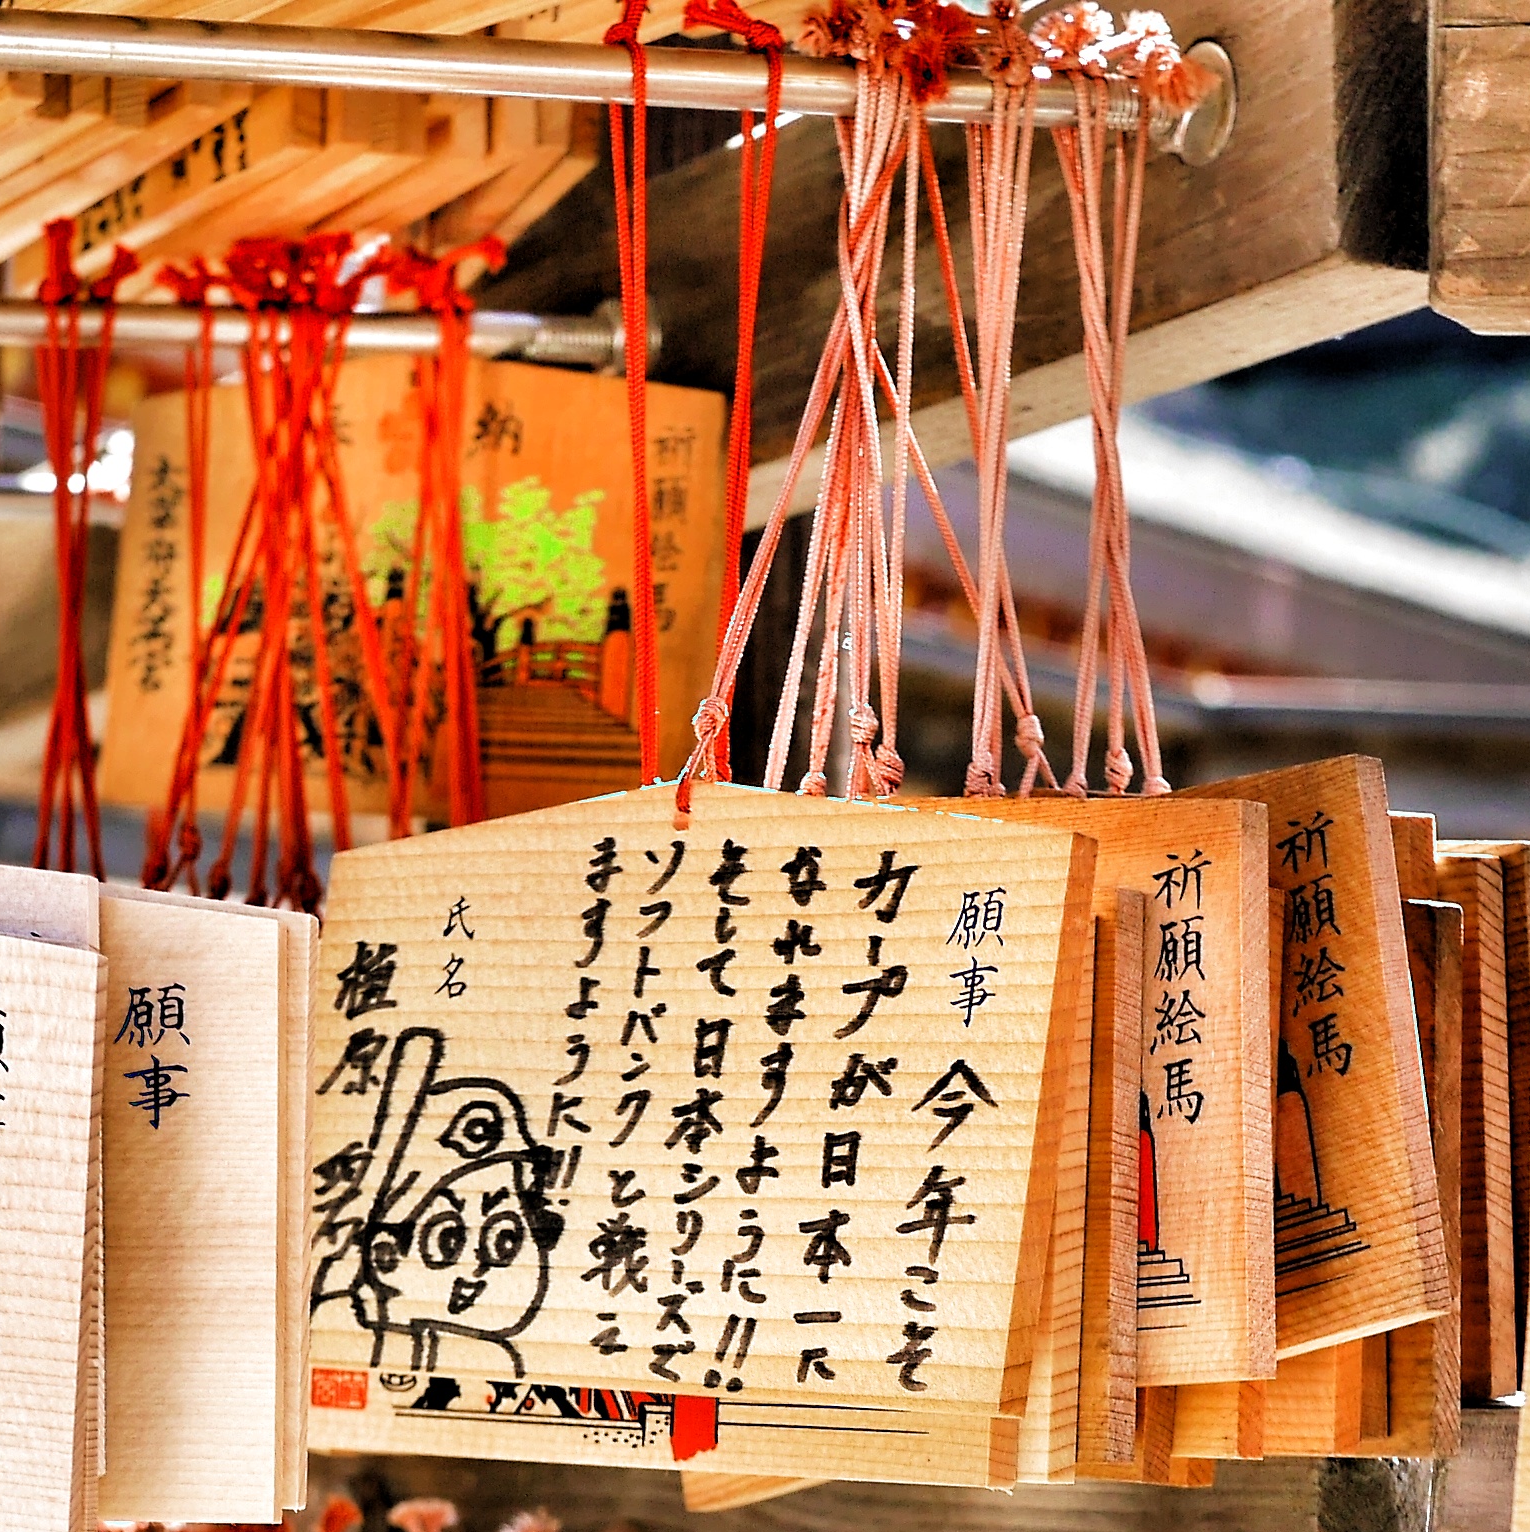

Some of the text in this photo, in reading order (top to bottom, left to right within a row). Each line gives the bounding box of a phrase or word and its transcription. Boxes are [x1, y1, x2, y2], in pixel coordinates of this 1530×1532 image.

[435, 897, 475, 998] 氏名
[946, 888, 1006, 1028] 願事
[1150, 848, 1213, 1126] 祈願絵馬
[1276, 811, 1354, 1078] 祈願絵馬
[113, 982, 193, 1132] 願事
[887, 1058, 999, 1394] 今年こそ
